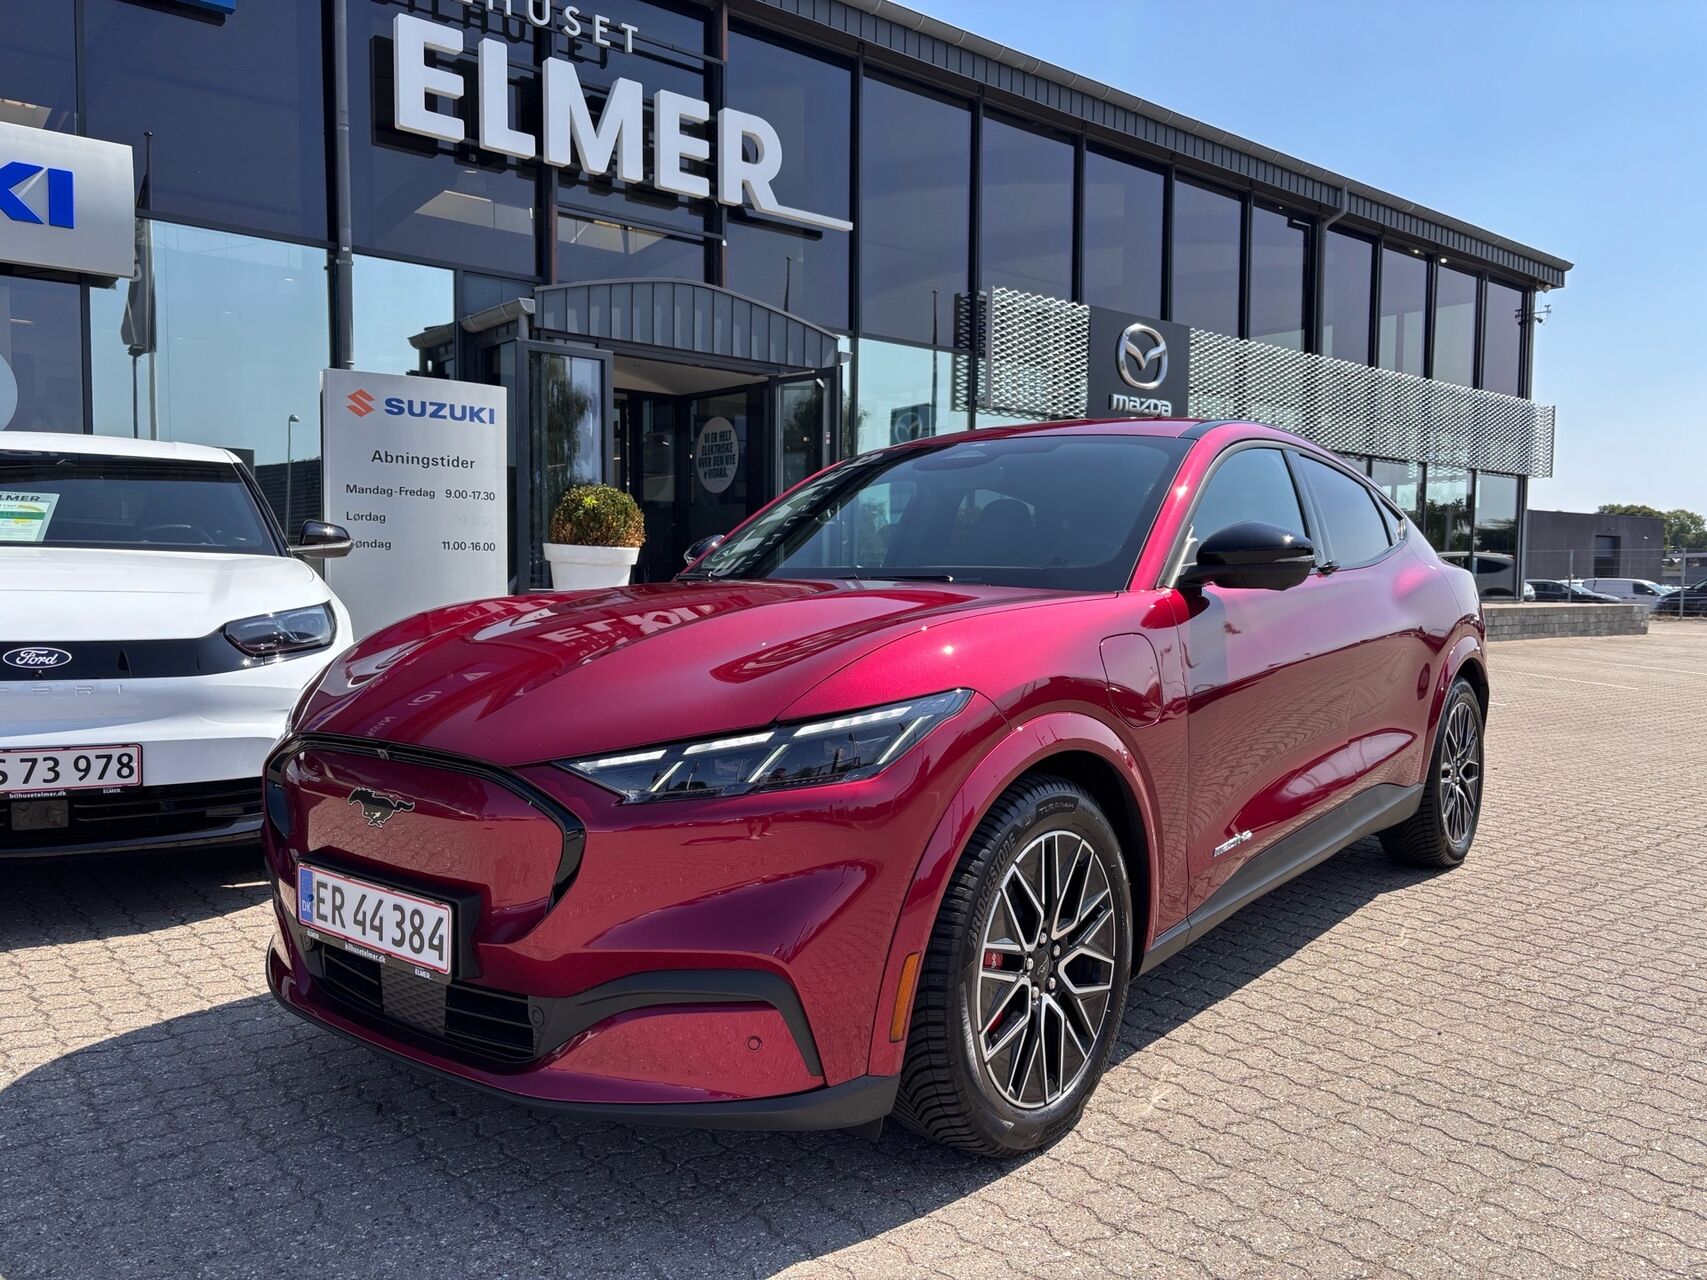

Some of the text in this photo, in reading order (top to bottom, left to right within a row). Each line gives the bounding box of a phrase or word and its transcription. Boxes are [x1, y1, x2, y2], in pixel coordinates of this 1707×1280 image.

[392, 13, 853, 232] ELMER
[385, 397, 495, 425] SUZUKI
[1111, 394, 1172, 417] mazda
[711, 431, 718, 443] ER
[719, 430, 732, 442] HELT
[702, 442, 733, 456] ELEKTRISKE
[371, 449, 476, 469] Abningstider
[698, 454, 736, 468] OVER DEN NYE
[346, 484, 436, 499] Mandag-Fredag
[346, 511, 386, 524] Lørdag
[16, 649, 58, 666] Ford
[19, 756, 60, 785] 73
[73, 753, 135, 782] 978
[9, 791, 67, 799] bilhusetelmer.dk
[301, 880, 444, 962] DK ER 44 384
